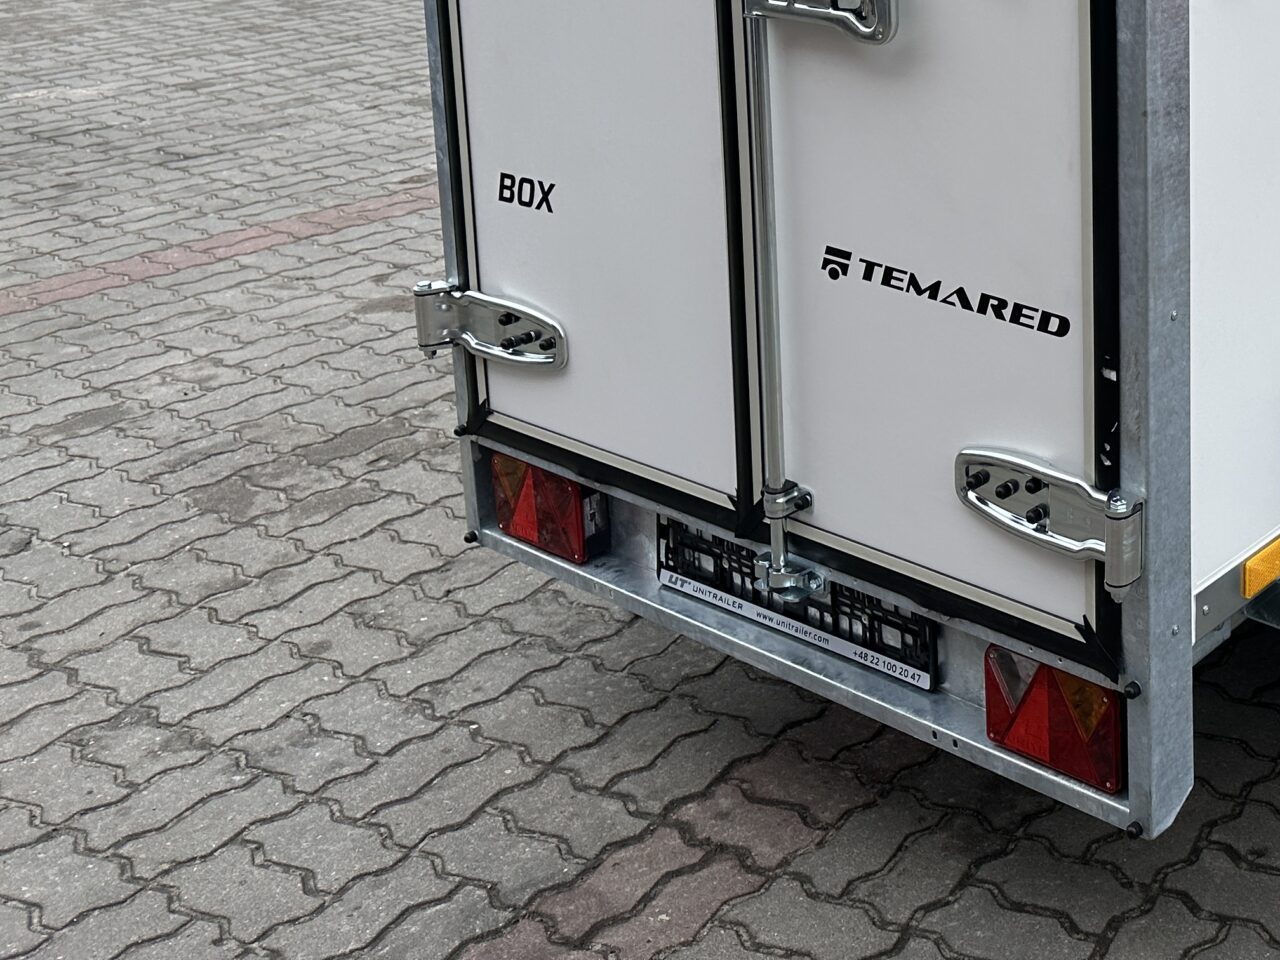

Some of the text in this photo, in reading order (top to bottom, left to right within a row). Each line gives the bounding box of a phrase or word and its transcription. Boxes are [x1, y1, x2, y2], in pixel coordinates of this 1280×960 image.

[498, 171, 556, 214] BOX
[858, 257, 1071, 338] TEMARED
[692, 584, 744, 612] UNITRAILER
[755, 609, 830, 646] www.unitrailer.com
[852, 649, 869, 662] +48
[870, 655, 880, 667] 22
[882, 660, 897, 674] 100
[898, 666, 909, 679] 20
[910, 672, 921, 684] 47
